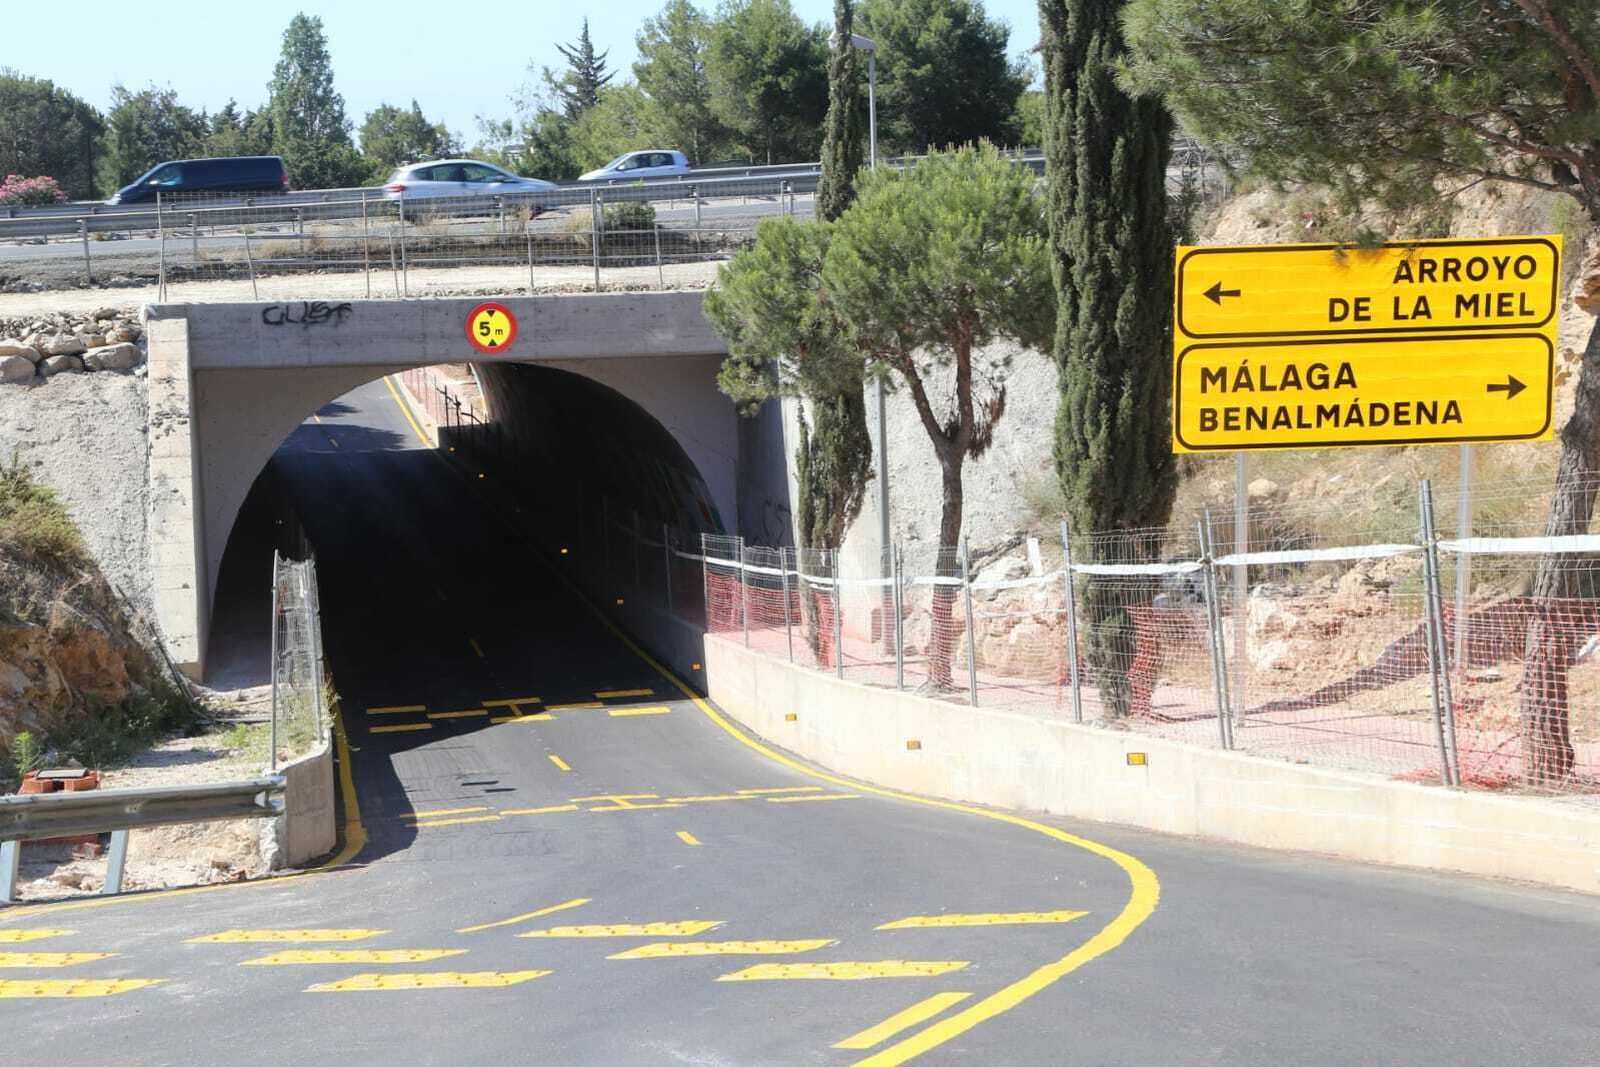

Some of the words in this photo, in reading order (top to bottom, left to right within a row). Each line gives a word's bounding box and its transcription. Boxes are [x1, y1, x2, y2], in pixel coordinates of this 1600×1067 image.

[1393, 255, 1537, 285] ARROYO
[1328, 297, 1372, 323] DE
[1393, 295, 1432, 321] LA
[1455, 292, 1535, 319] MIEL
[480, 321, 491, 337] 5
[494, 328, 503, 336] m
[1200, 359, 1358, 394] MÁLAGA
[1199, 398, 1463, 433] BENALMÁDENA
